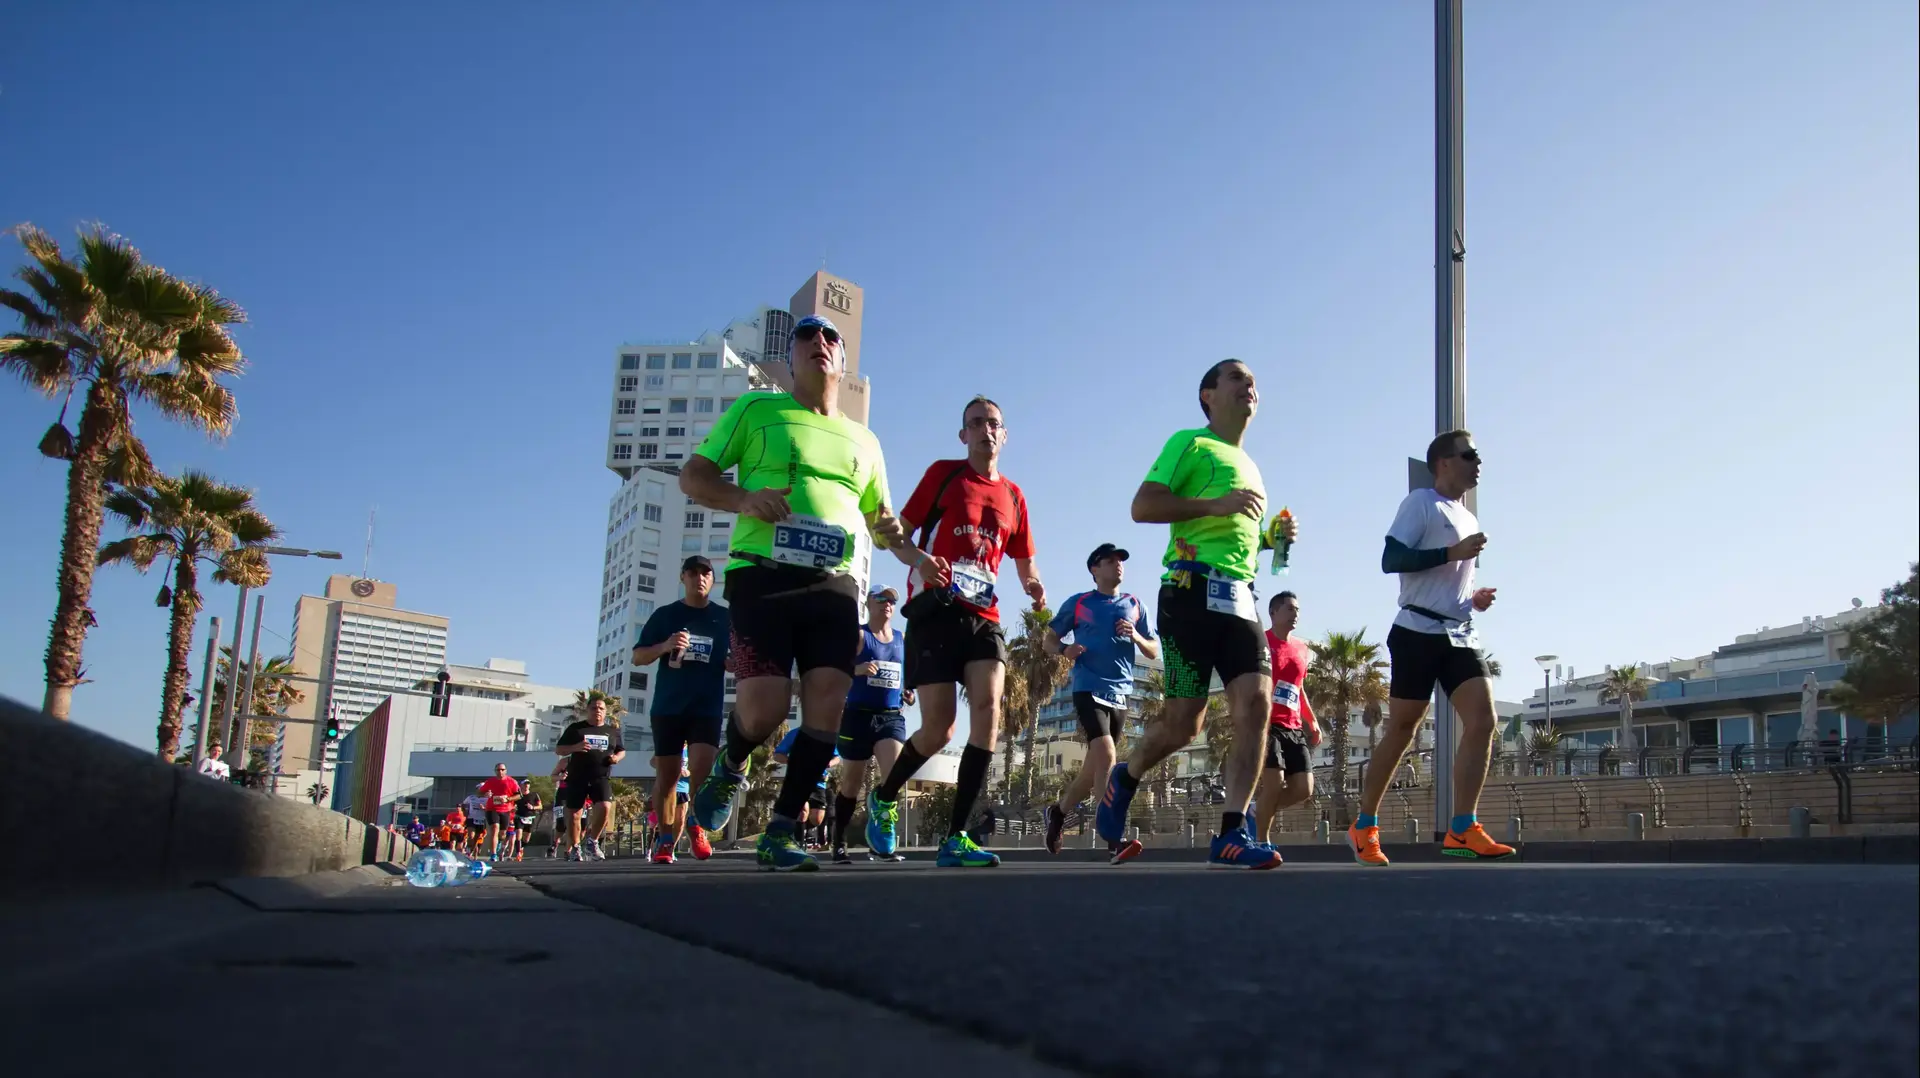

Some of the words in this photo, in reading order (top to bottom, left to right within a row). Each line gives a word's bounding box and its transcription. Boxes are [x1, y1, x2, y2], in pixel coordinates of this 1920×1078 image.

[777, 529, 789, 544] B
[798, 532, 839, 554] 1453
[954, 574, 961, 584] B
[1210, 582, 1220, 595] B
